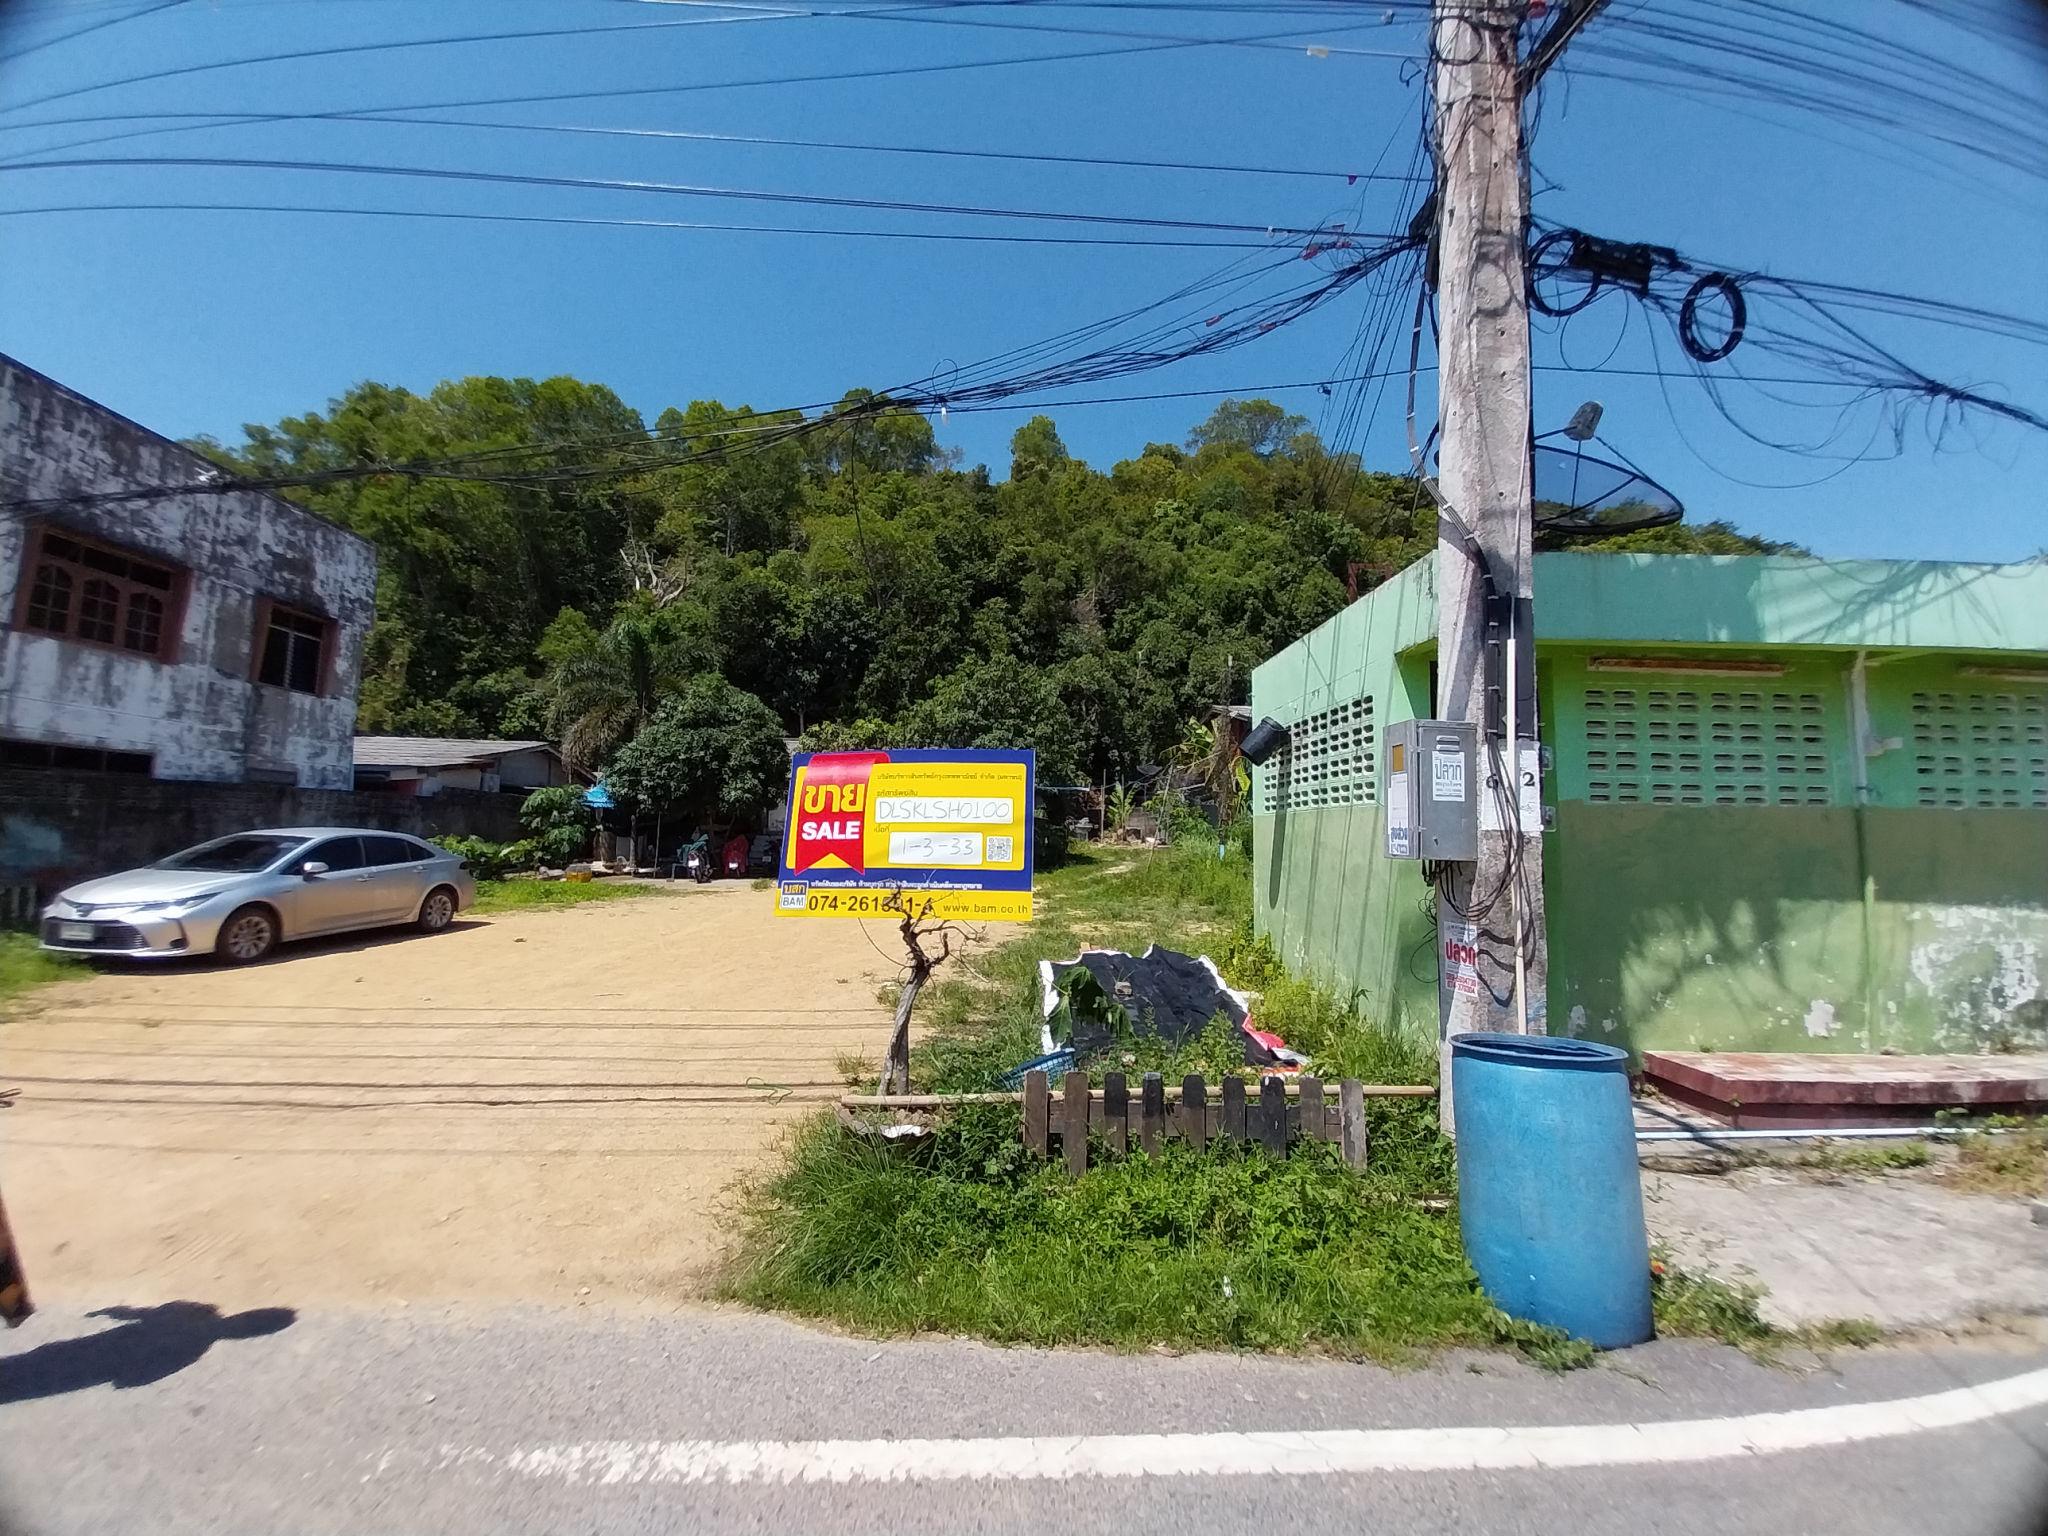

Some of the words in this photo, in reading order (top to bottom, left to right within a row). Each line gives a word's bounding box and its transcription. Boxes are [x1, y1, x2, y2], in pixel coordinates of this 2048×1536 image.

[1522, 771, 1536, 787] 2
[804, 783, 866, 814] ขาย
[801, 821, 861, 841] SALE
[782, 896, 804, 907] BAM
[942, 903, 1029, 914] www.bam.co.th
[1446, 938, 1476, 965] ปลวก
